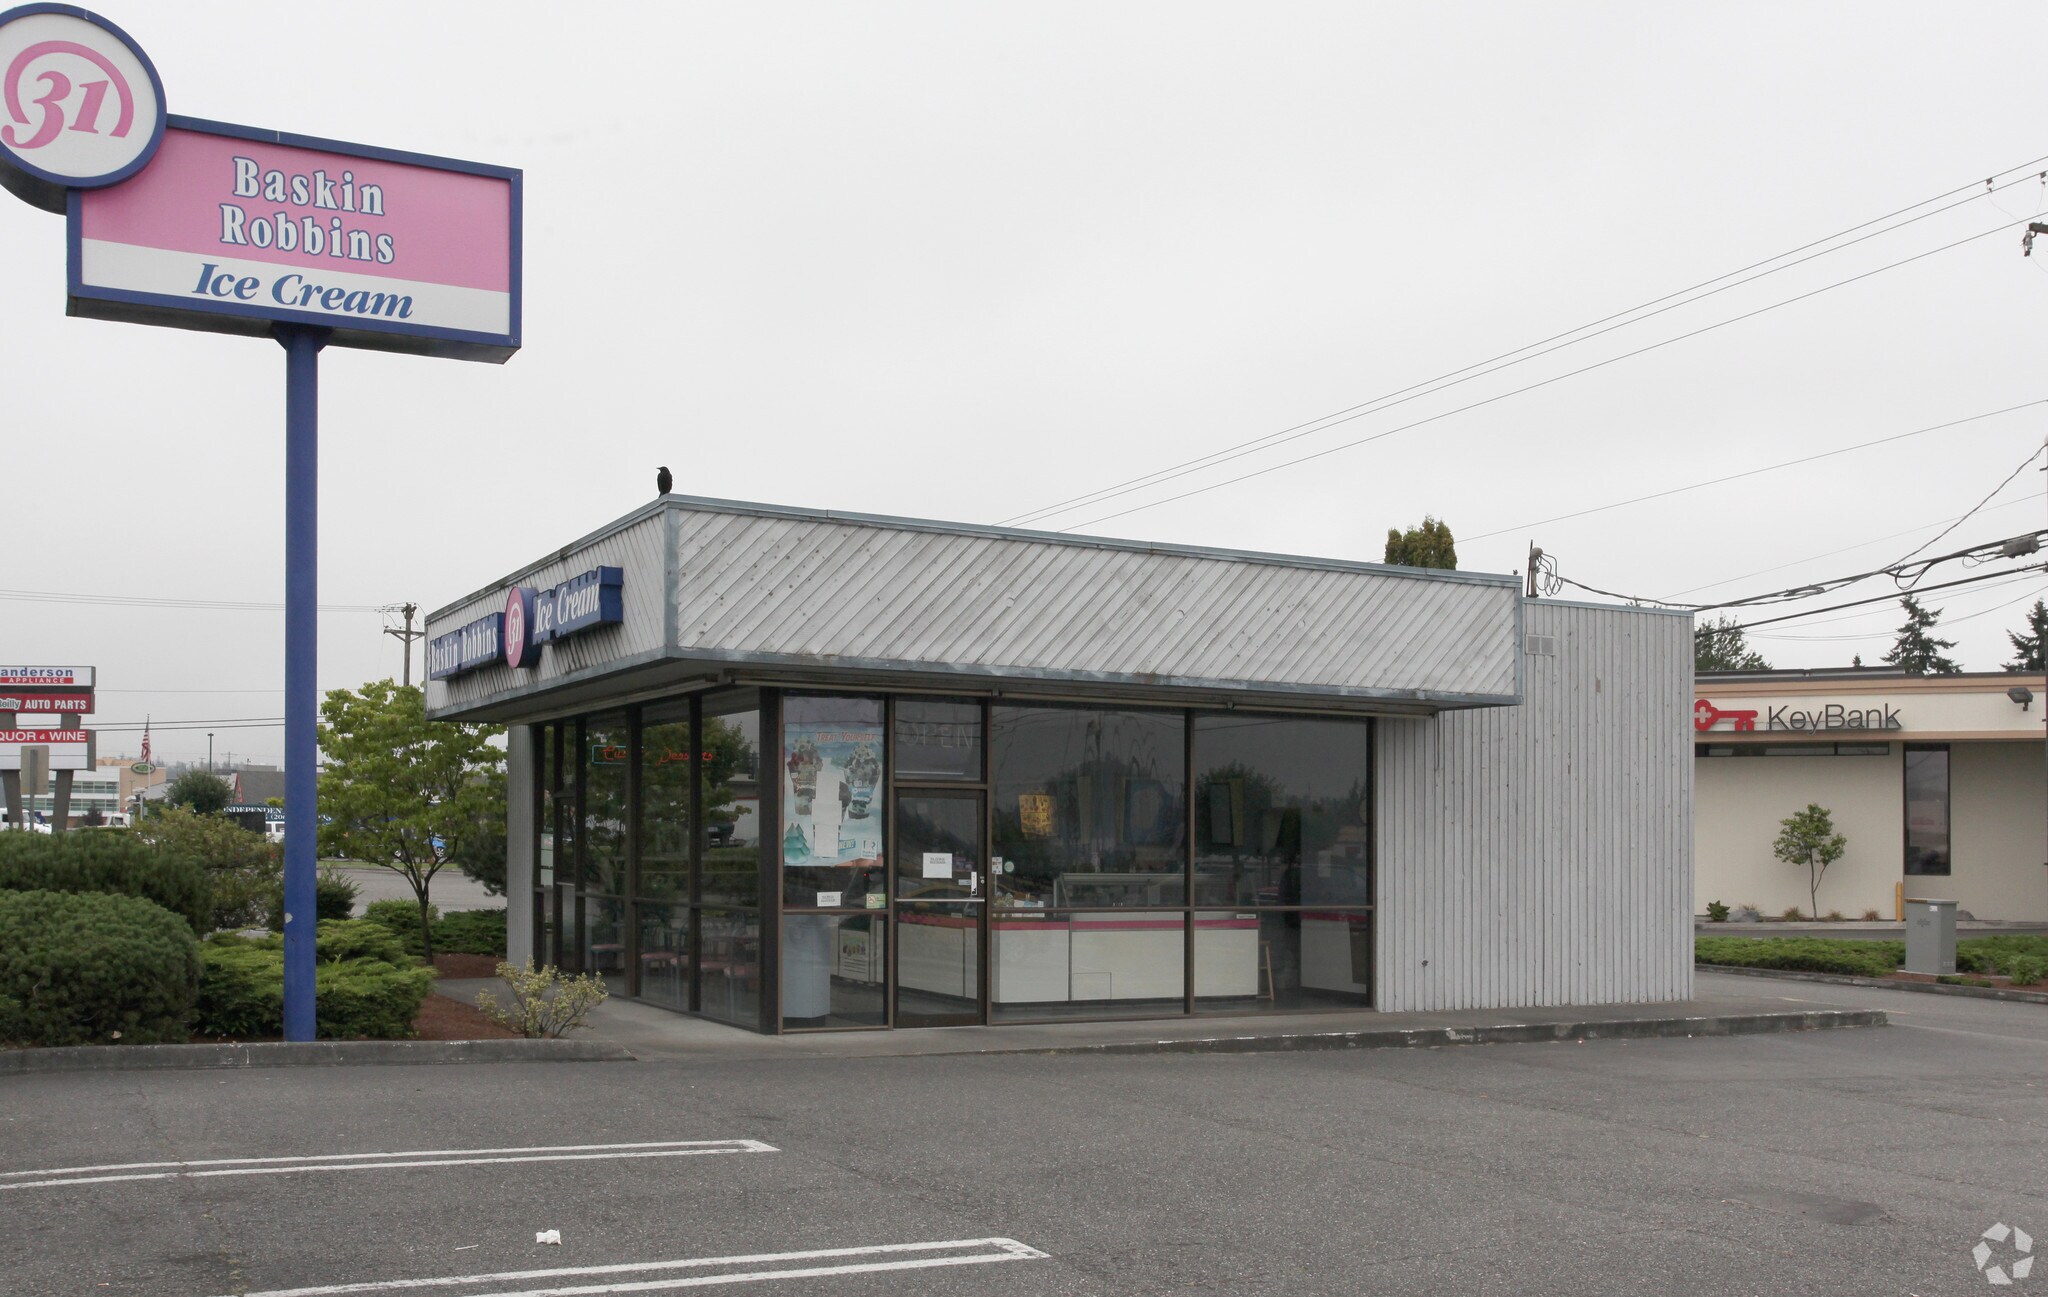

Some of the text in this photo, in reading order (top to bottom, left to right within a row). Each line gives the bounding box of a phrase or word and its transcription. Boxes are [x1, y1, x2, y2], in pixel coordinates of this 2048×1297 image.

[1, 71, 109, 149] 31
[233, 156, 385, 217] Baskin
[220, 203, 395, 264] Robbins
[192, 263, 414, 319] Ice Cream
[534, 582, 600, 634] Ice Cream
[0, 667, 73, 677] anderson
[430, 624, 497, 674] Baskin Robbins
[25, 700, 50, 709] AUTO
[54, 700, 86, 710] PARTS
[1767, 703, 1903, 735] KeyBank
[49, 731, 86, 741] WINE
[903, 723, 974, 750] OPEN
